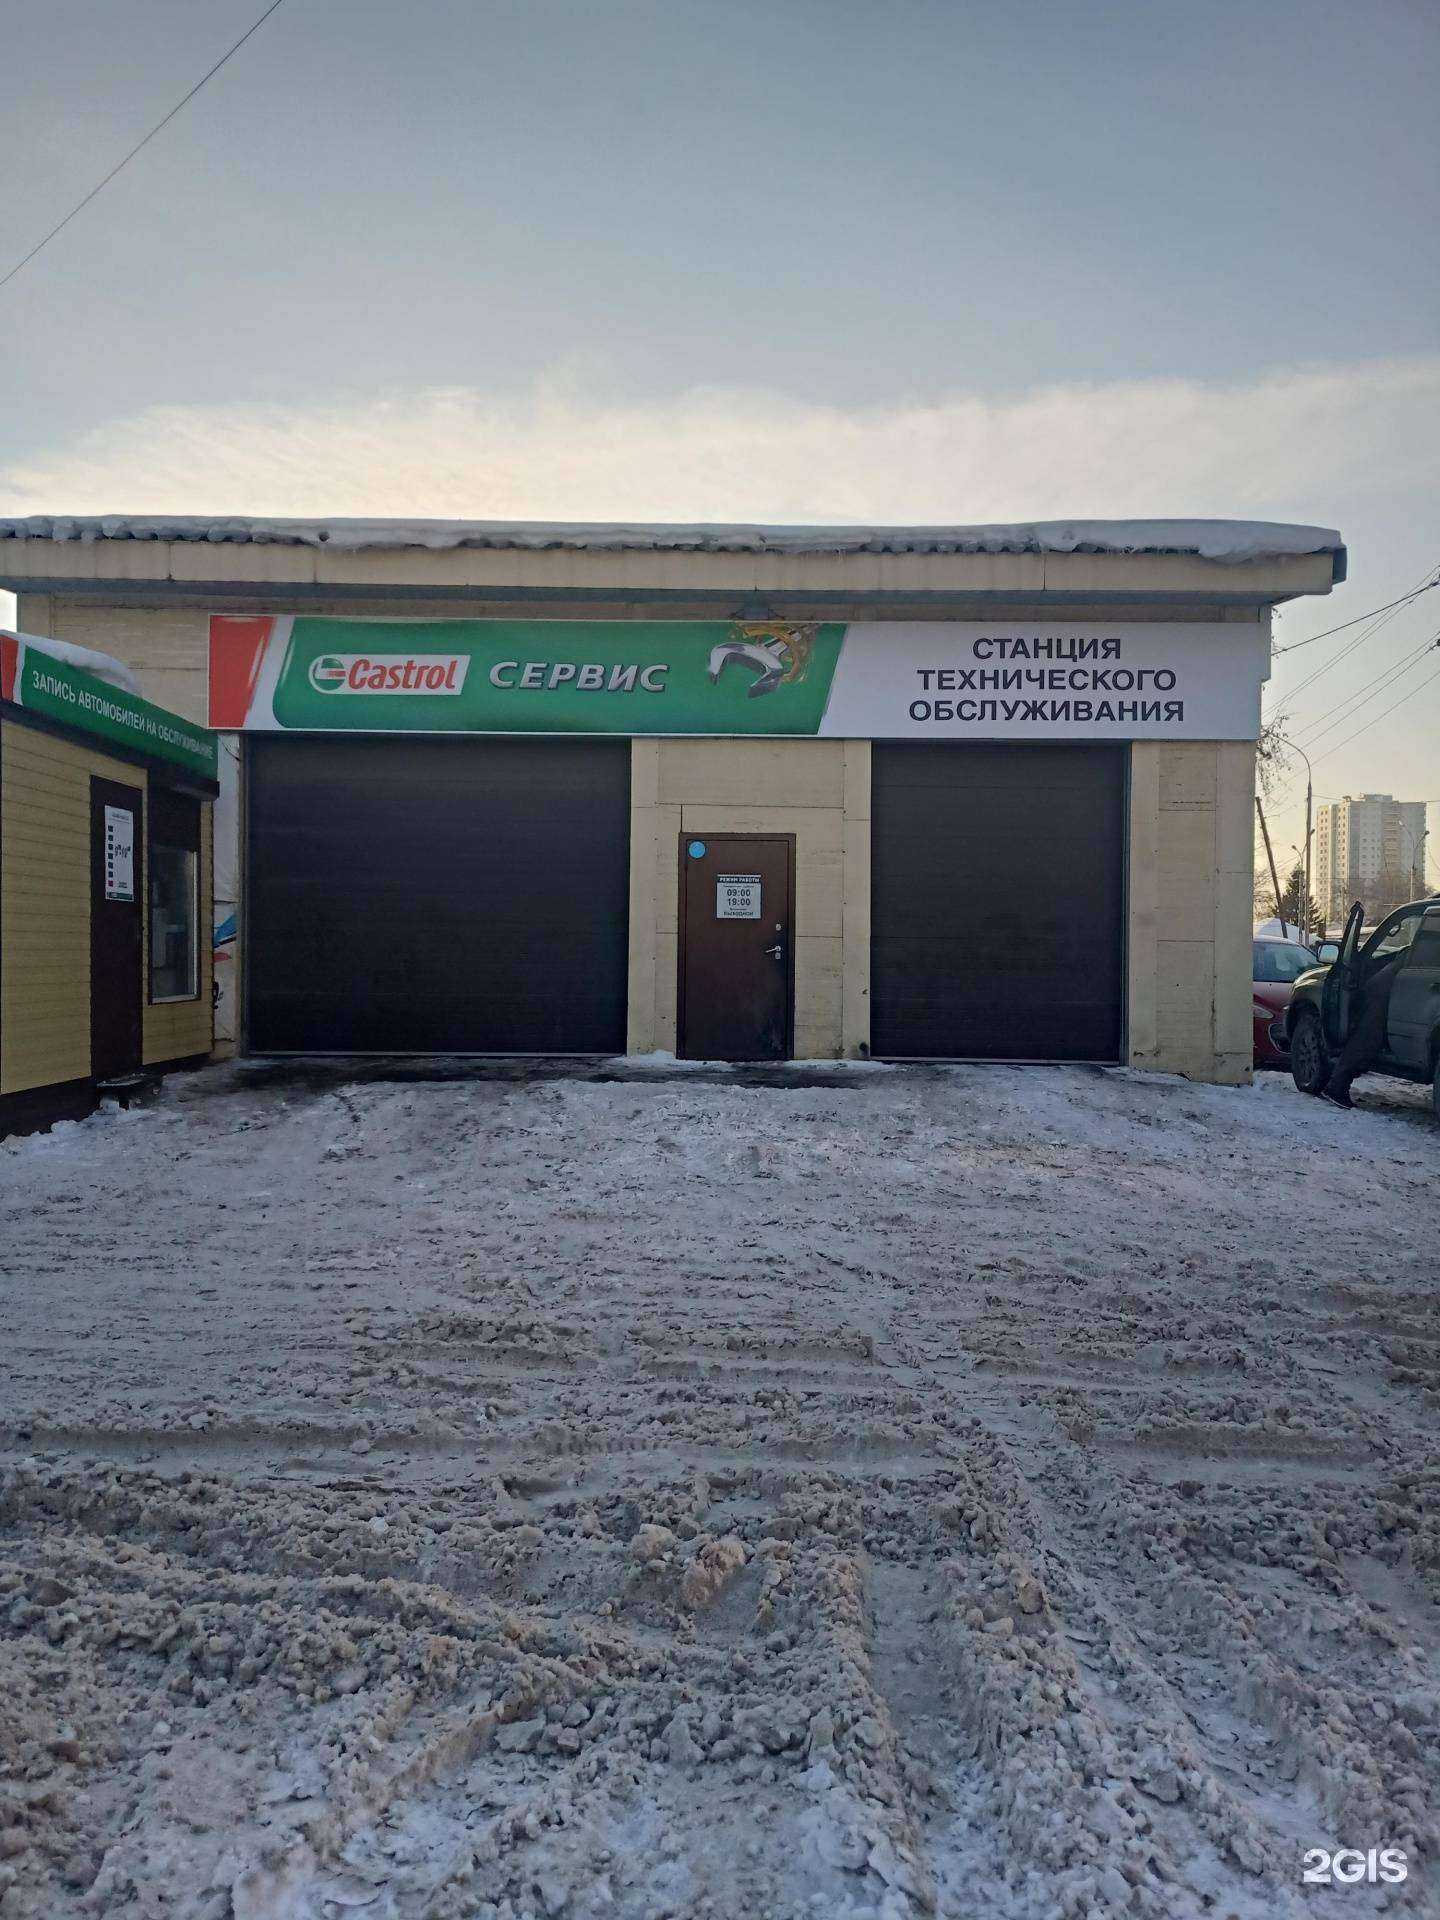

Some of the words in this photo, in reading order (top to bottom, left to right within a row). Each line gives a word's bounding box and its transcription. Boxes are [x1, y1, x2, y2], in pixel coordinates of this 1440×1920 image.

[972, 638, 1121, 662] СТАНЦИЯ
[349, 658, 459, 690] Castrol
[489, 661, 669, 692] СЕРВИС
[917, 669, 1177, 691] ТЕХНИЧЕСКОГО
[32, 670, 76, 703] ЗАПИСЬ
[78, 690, 145, 731] АВТОМОБИЛЕЙ
[146, 720, 157, 735] НА
[909, 700, 1184, 722] ОБСЛУЖИВАНИЯ
